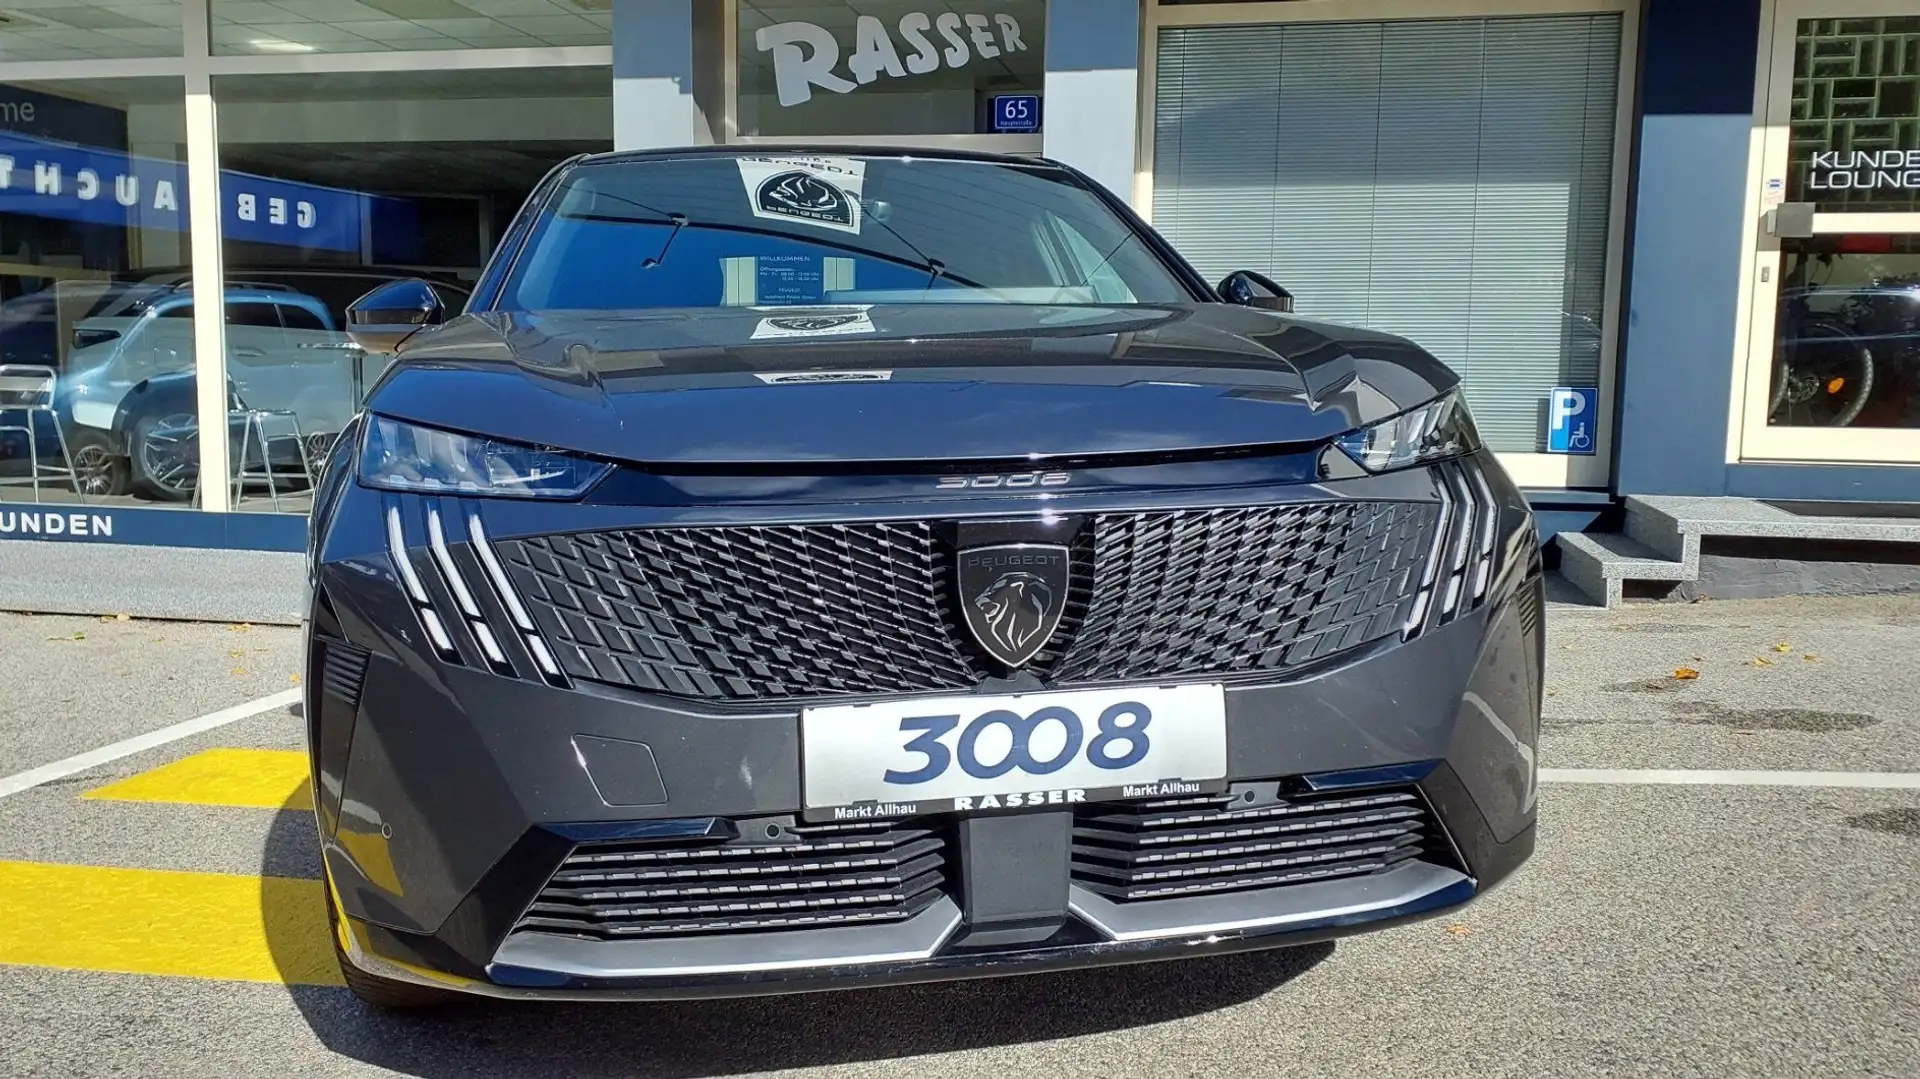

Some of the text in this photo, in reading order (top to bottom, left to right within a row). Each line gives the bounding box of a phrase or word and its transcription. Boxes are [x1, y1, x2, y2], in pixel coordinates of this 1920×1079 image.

[756, 12, 1027, 107] RASSER
[1005, 100, 1028, 119] 65
[1553, 391, 1586, 430] P
[936, 472, 1072, 489] 3008
[968, 555, 1060, 567] PEUGEOT
[883, 701, 1152, 784] 3008
[954, 788, 1087, 810] RASSER
[1123, 782, 1200, 798] Markt Allhau
[834, 804, 917, 819] Markt Allhau
